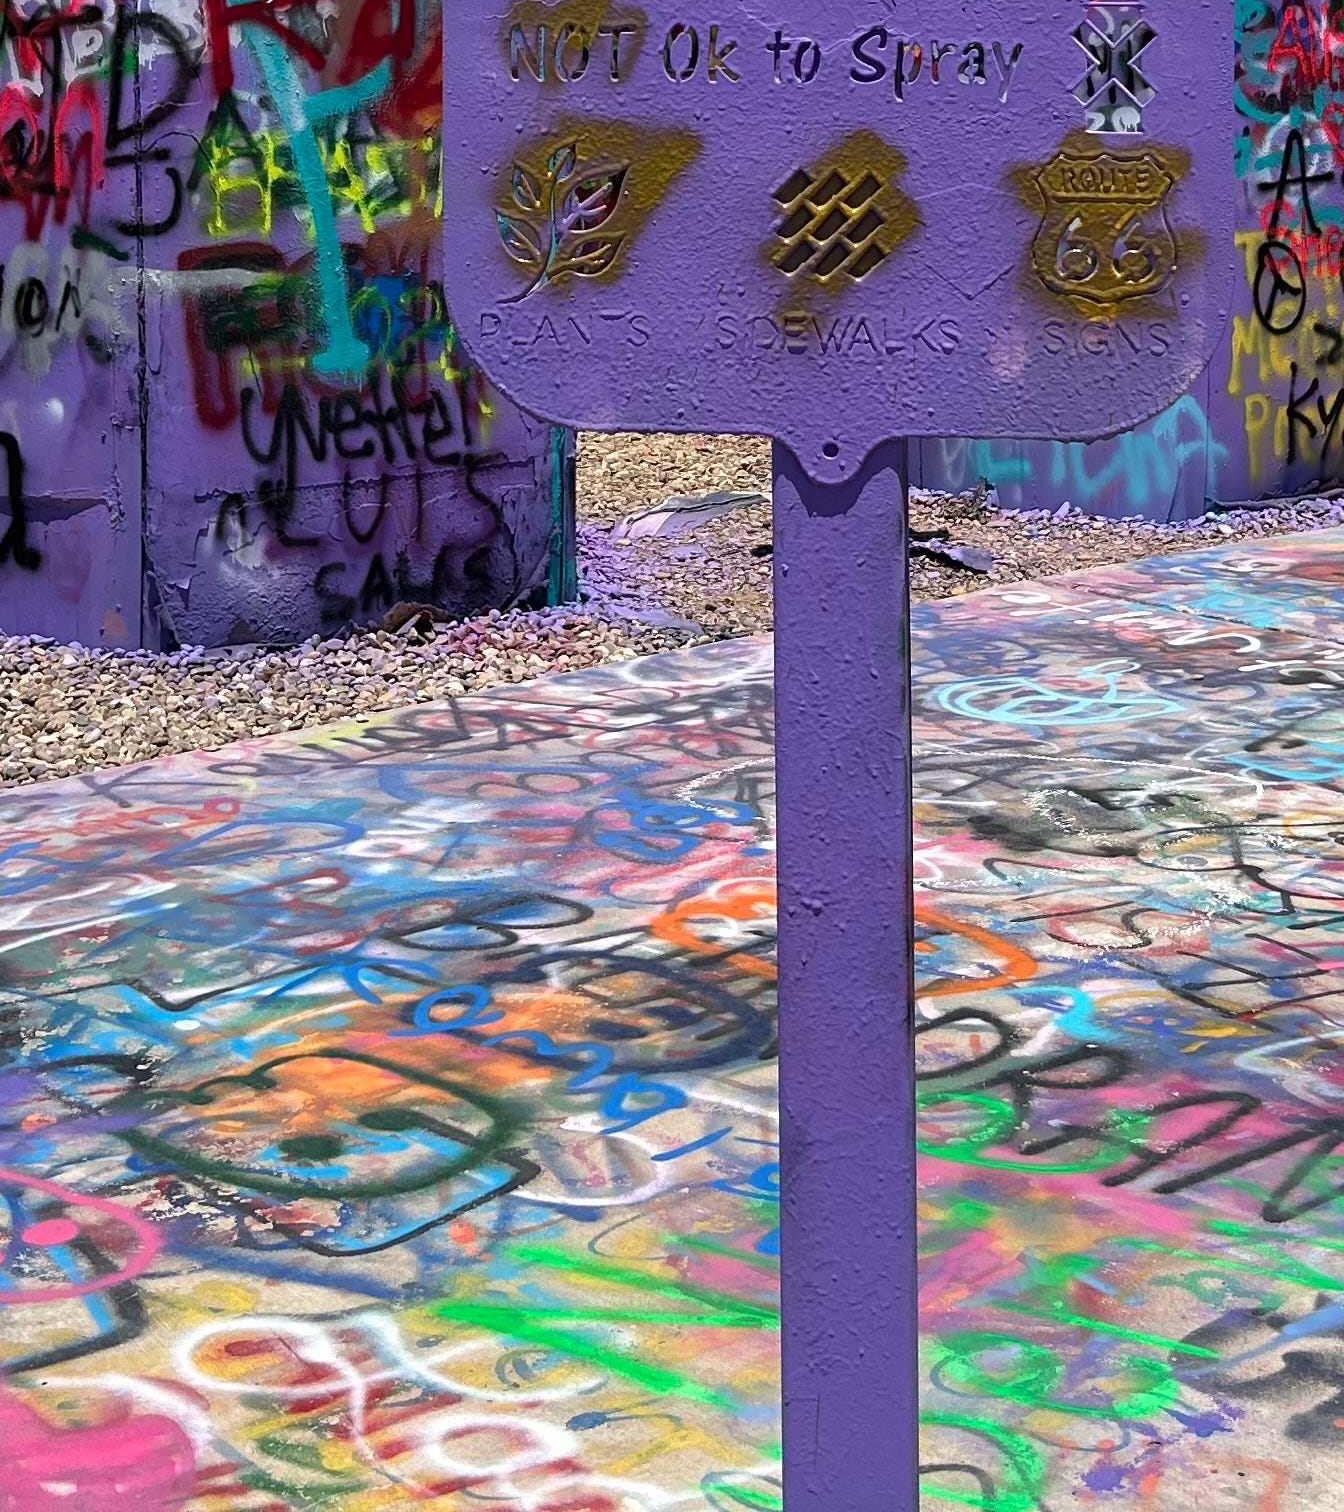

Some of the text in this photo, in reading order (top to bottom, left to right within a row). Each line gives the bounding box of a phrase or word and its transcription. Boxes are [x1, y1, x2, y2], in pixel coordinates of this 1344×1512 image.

[508, 21, 1025, 103] NOT Ok to Spray
[1057, 165, 1154, 194] ROUTE
[1055, 216, 1156, 283] 66
[480, 312, 652, 352] PLANTS
[717, 311, 962, 355] SIDEWALKS
[1043, 314, 1172, 359] SIGNS
